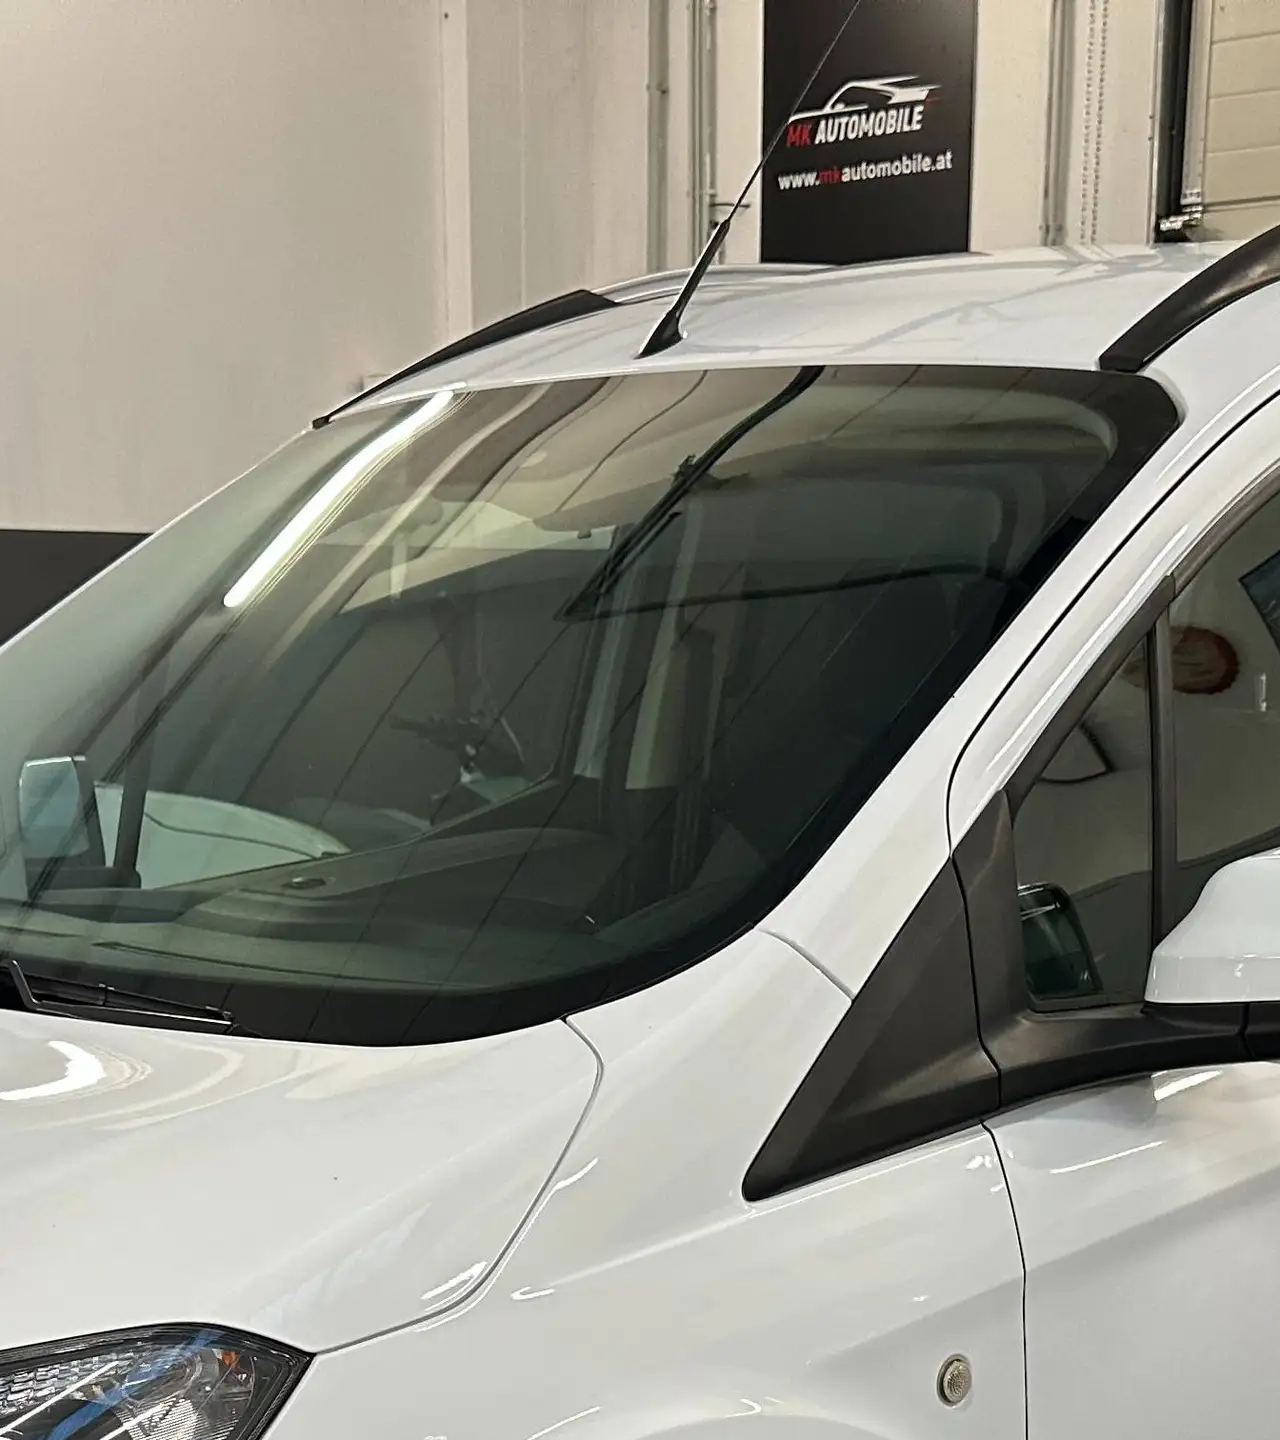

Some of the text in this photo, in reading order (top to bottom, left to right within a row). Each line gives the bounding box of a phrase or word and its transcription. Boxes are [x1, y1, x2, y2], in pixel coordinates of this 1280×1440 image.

[786, 105, 925, 147] MK AUTOMOBILE
[778, 150, 953, 190] www.mkautomobile.at
